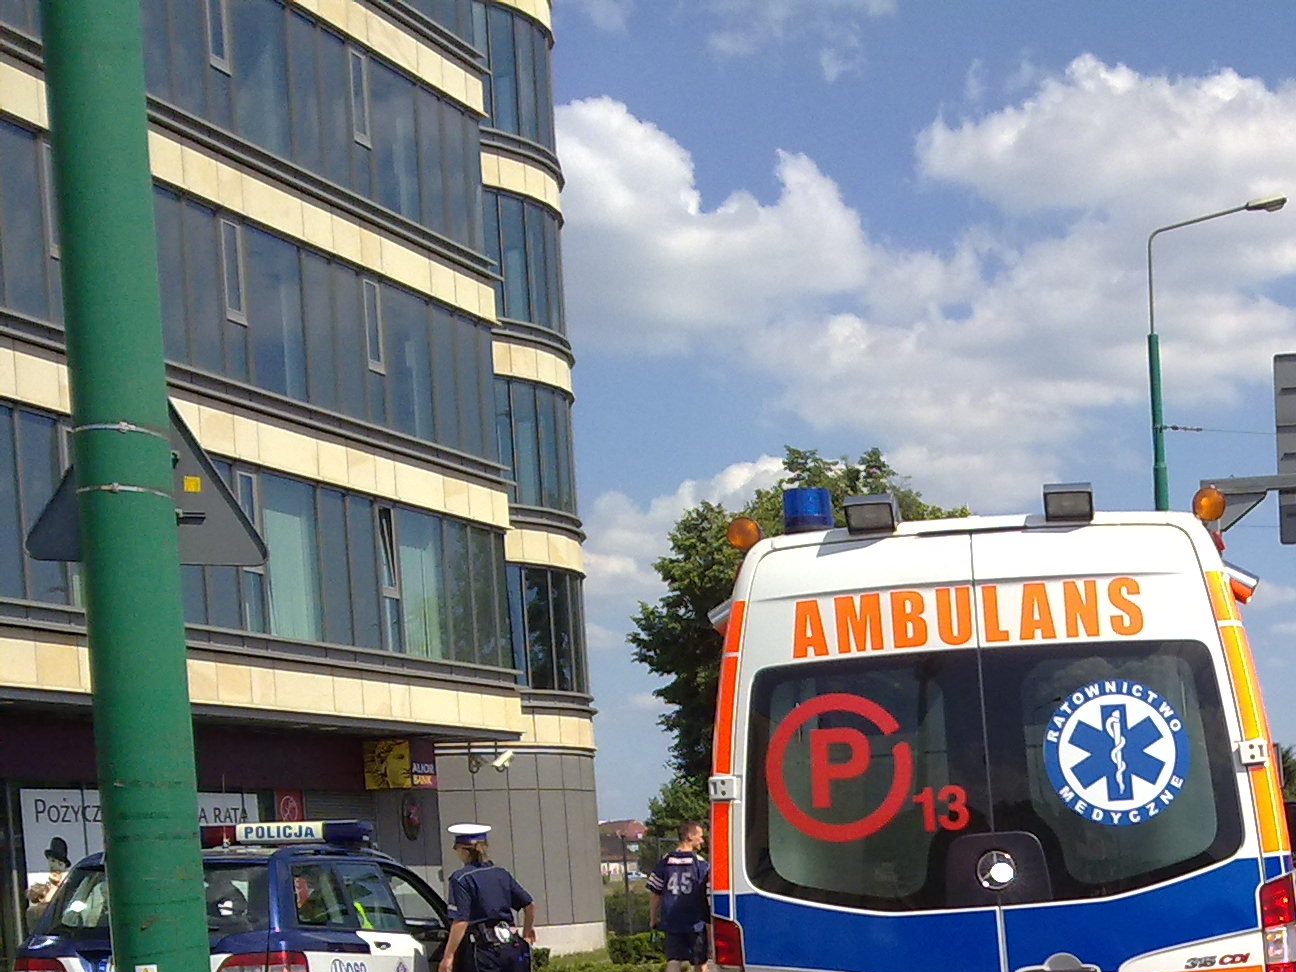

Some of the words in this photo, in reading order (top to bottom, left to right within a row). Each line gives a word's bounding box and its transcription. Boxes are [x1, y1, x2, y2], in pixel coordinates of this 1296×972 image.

[793, 576, 1144, 659] AMBULANS
[1047, 680, 1182, 743] RATOWNICTWO
[810, 727, 871, 808] P
[912, 784, 970, 832] 13
[1059, 775, 1184, 825] MEDYCZNE
[244, 826, 314, 839] POLICJA
[667, 872, 693, 895] 45
[1219, 952, 1250, 966] CDI
